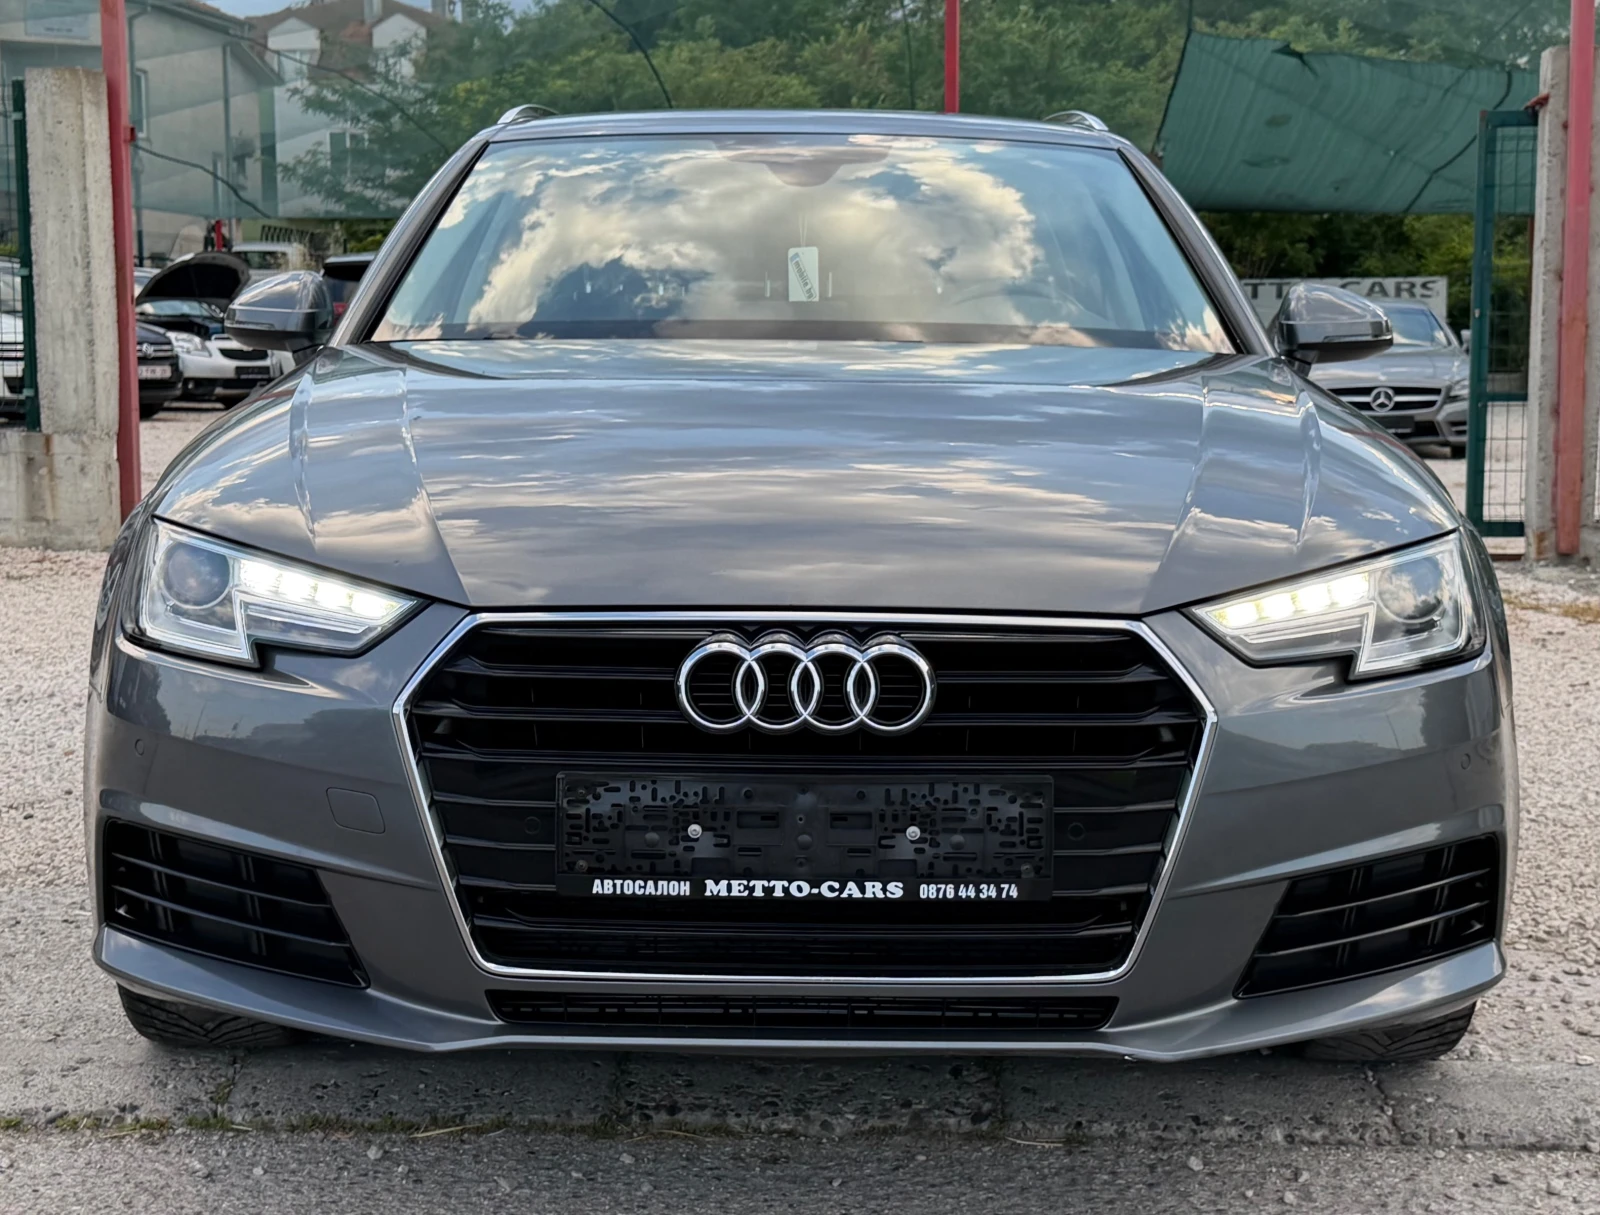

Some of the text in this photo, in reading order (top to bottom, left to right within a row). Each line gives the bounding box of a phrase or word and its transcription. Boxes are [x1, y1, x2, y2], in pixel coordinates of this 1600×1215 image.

[591, 878, 1019, 899] АВТОСАЛОН METTO-CARS 0876 44 34 74
